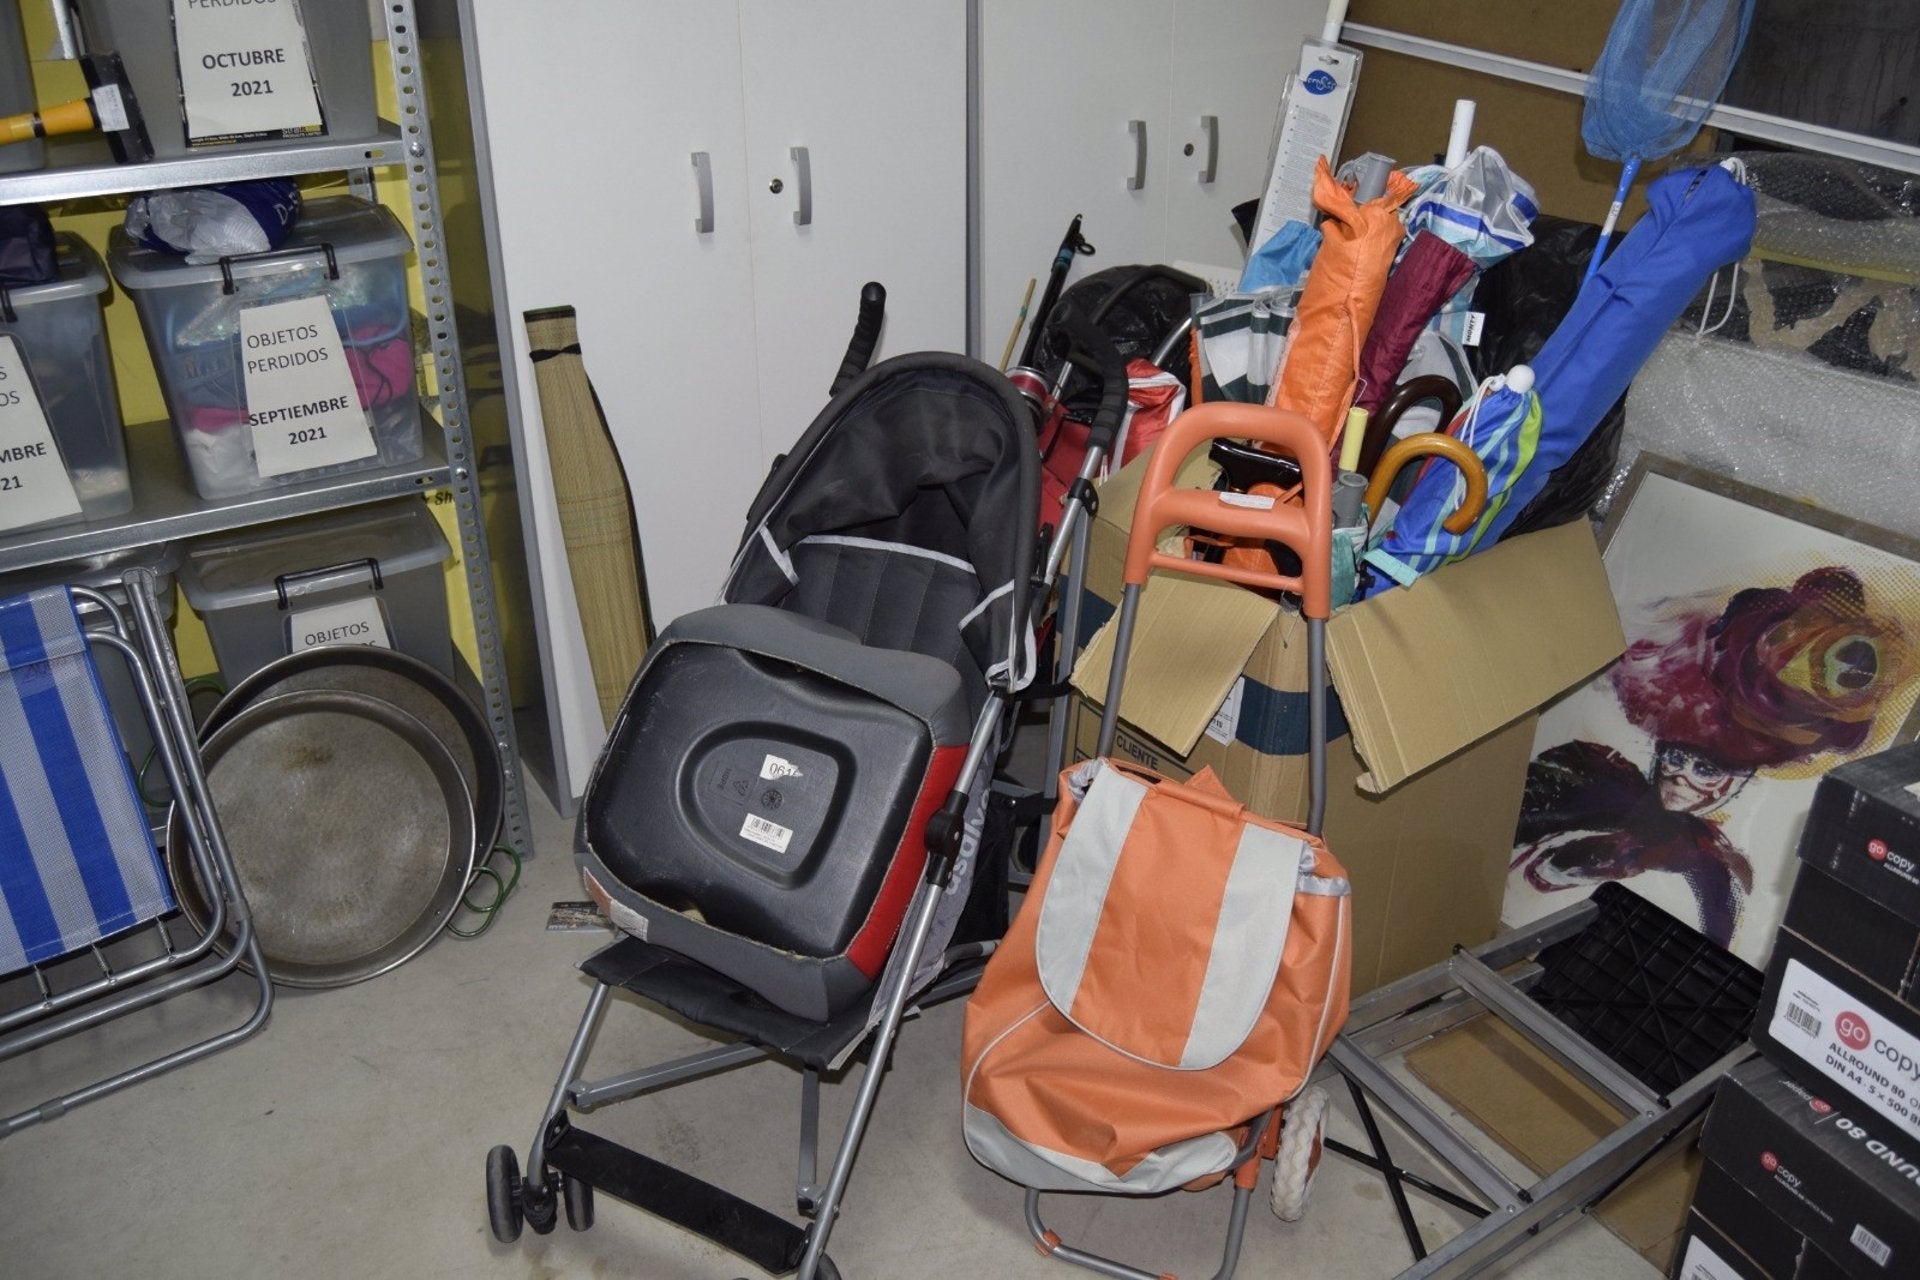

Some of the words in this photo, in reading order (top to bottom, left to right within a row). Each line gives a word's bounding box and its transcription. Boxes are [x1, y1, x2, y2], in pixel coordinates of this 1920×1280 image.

[202, 48, 286, 69] OCTUBRE
[231, 80, 274, 97] 2021
[247, 325, 318, 348] OBJETOS
[248, 347, 329, 374] PERDIDOS
[249, 395, 349, 426] SEPTIEMBRE
[288, 427, 327, 445] 2021
[0, 475, 23, 491] 21
[305, 621, 369, 645] OBJETOS
[1116, 734, 1159, 771] CLIENTE
[1886, 851, 1915, 872] copy
[1839, 1018, 1866, 1041] go
[1874, 1039, 1920, 1081] copy
[1829, 1042, 1889, 1087] ALLROUND
[1891, 1084, 1905, 1099] 80
[1825, 1054, 1846, 1074] DIN
[1847, 1069, 1862, 1084] A4
[1868, 1085, 1875, 1094] 5
[1886, 1098, 1908, 1117] 500
[1835, 1118, 1867, 1139] 80
[1777, 1165, 1802, 1188] copy
